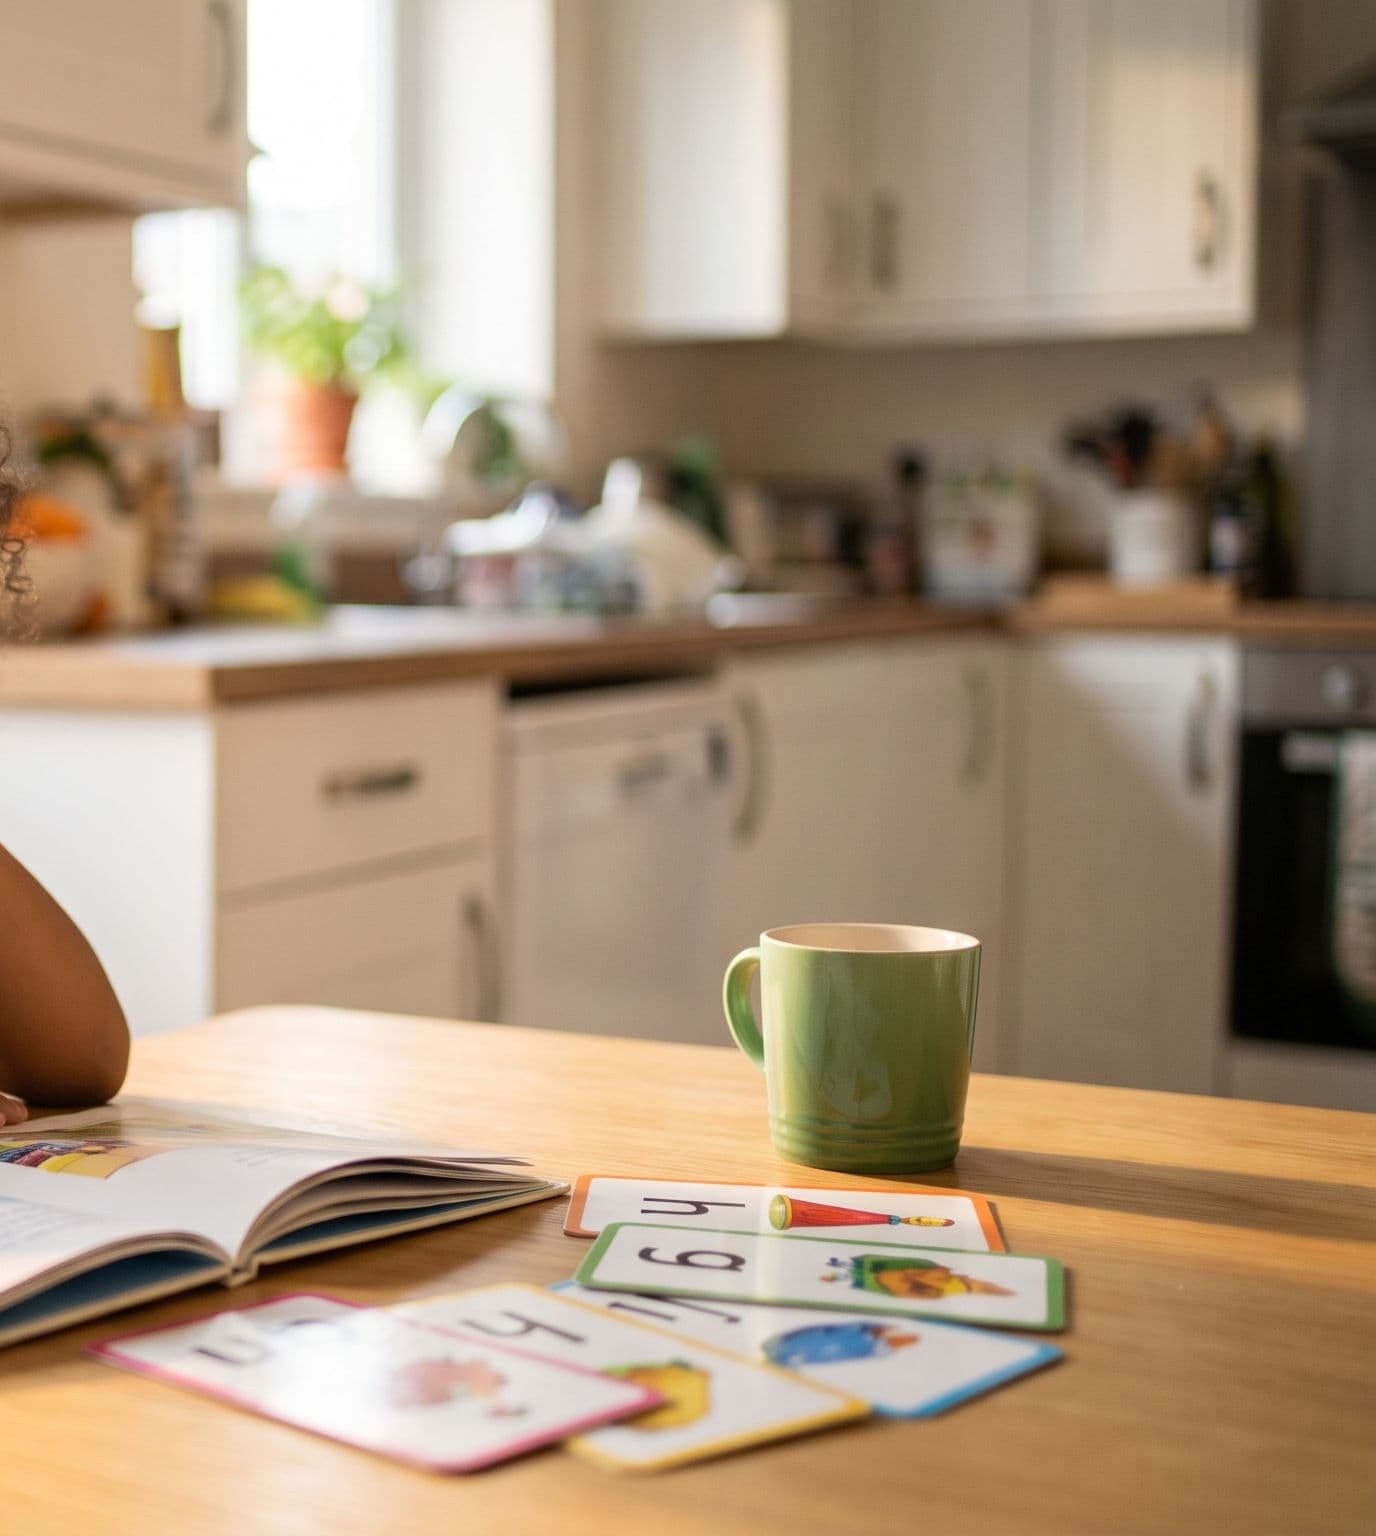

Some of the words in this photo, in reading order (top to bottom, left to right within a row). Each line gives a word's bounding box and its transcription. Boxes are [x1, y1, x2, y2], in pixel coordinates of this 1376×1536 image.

[640, 1197, 746, 1216] h
[638, 1246, 746, 1272] g
[459, 1310, 587, 1344] h
